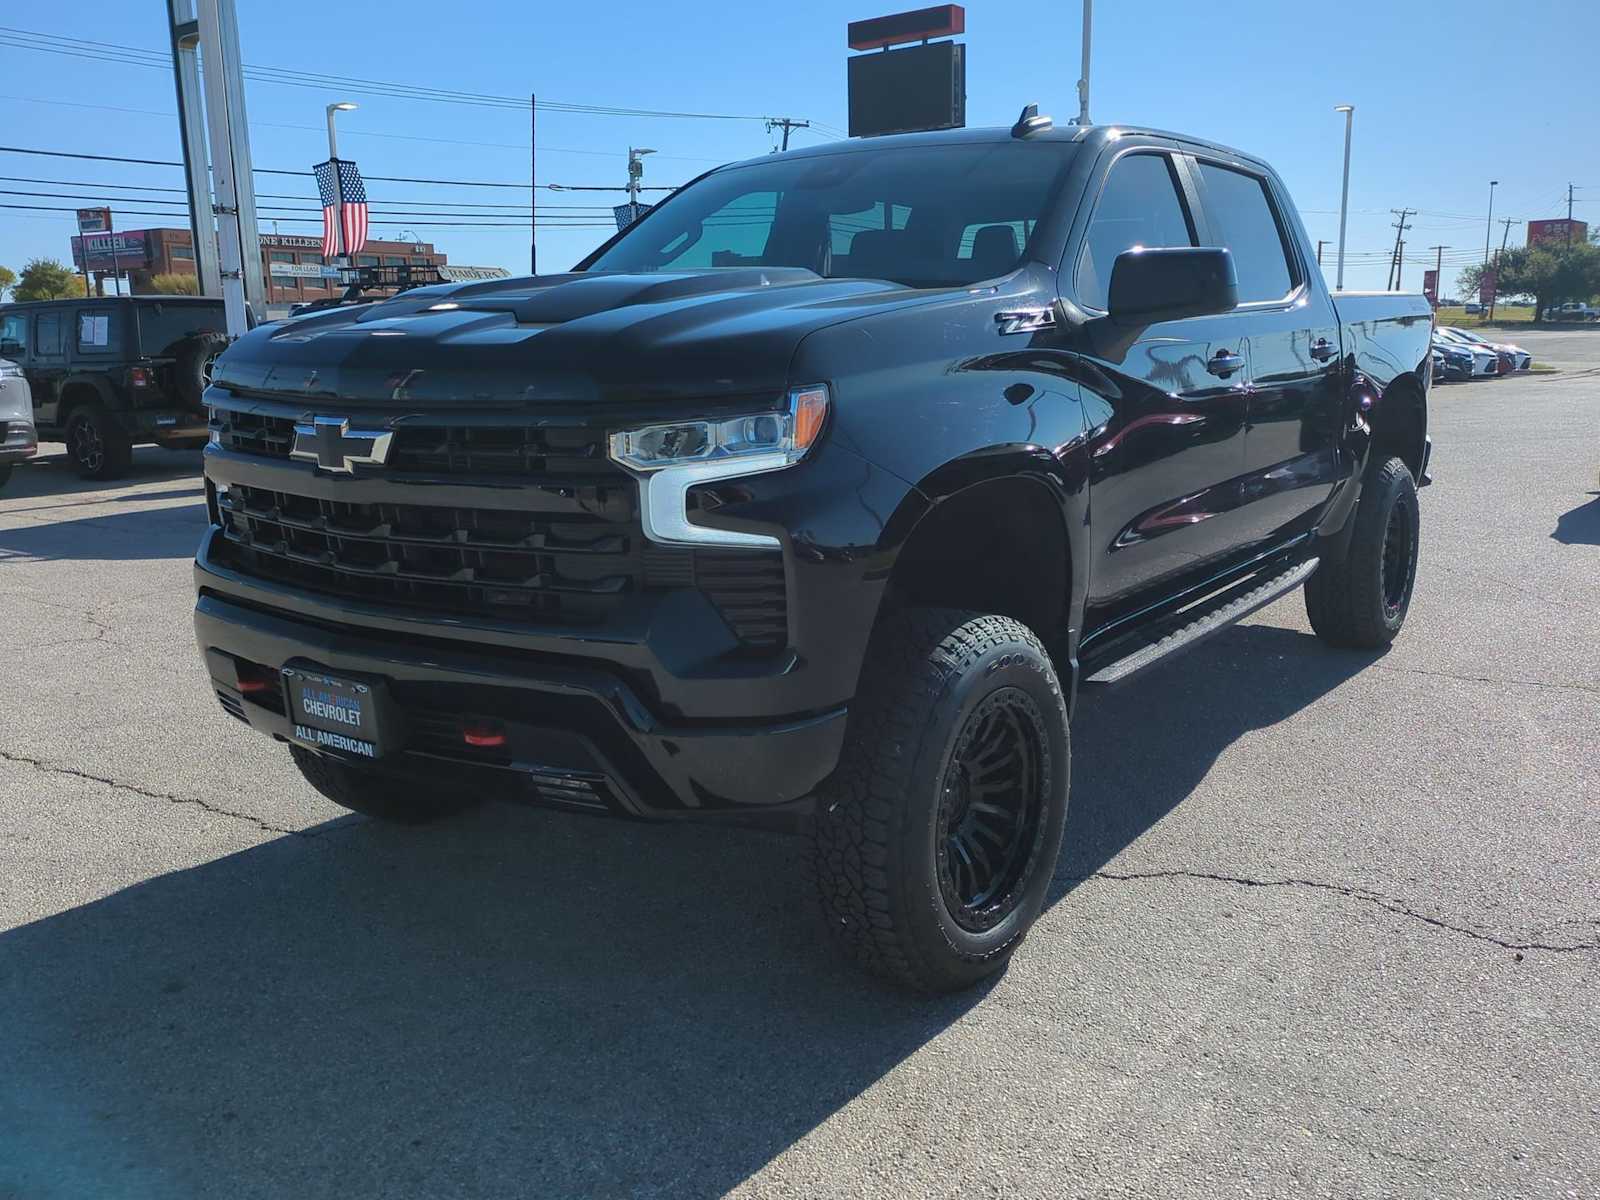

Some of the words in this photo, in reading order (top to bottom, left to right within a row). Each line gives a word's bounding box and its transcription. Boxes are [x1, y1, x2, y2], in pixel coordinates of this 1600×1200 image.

[281, 238, 324, 248] KILLEEN
[303, 698, 361, 727] CHEVROLET
[295, 725, 315, 742] ALL
[317, 730, 374, 758] AMERICAN
